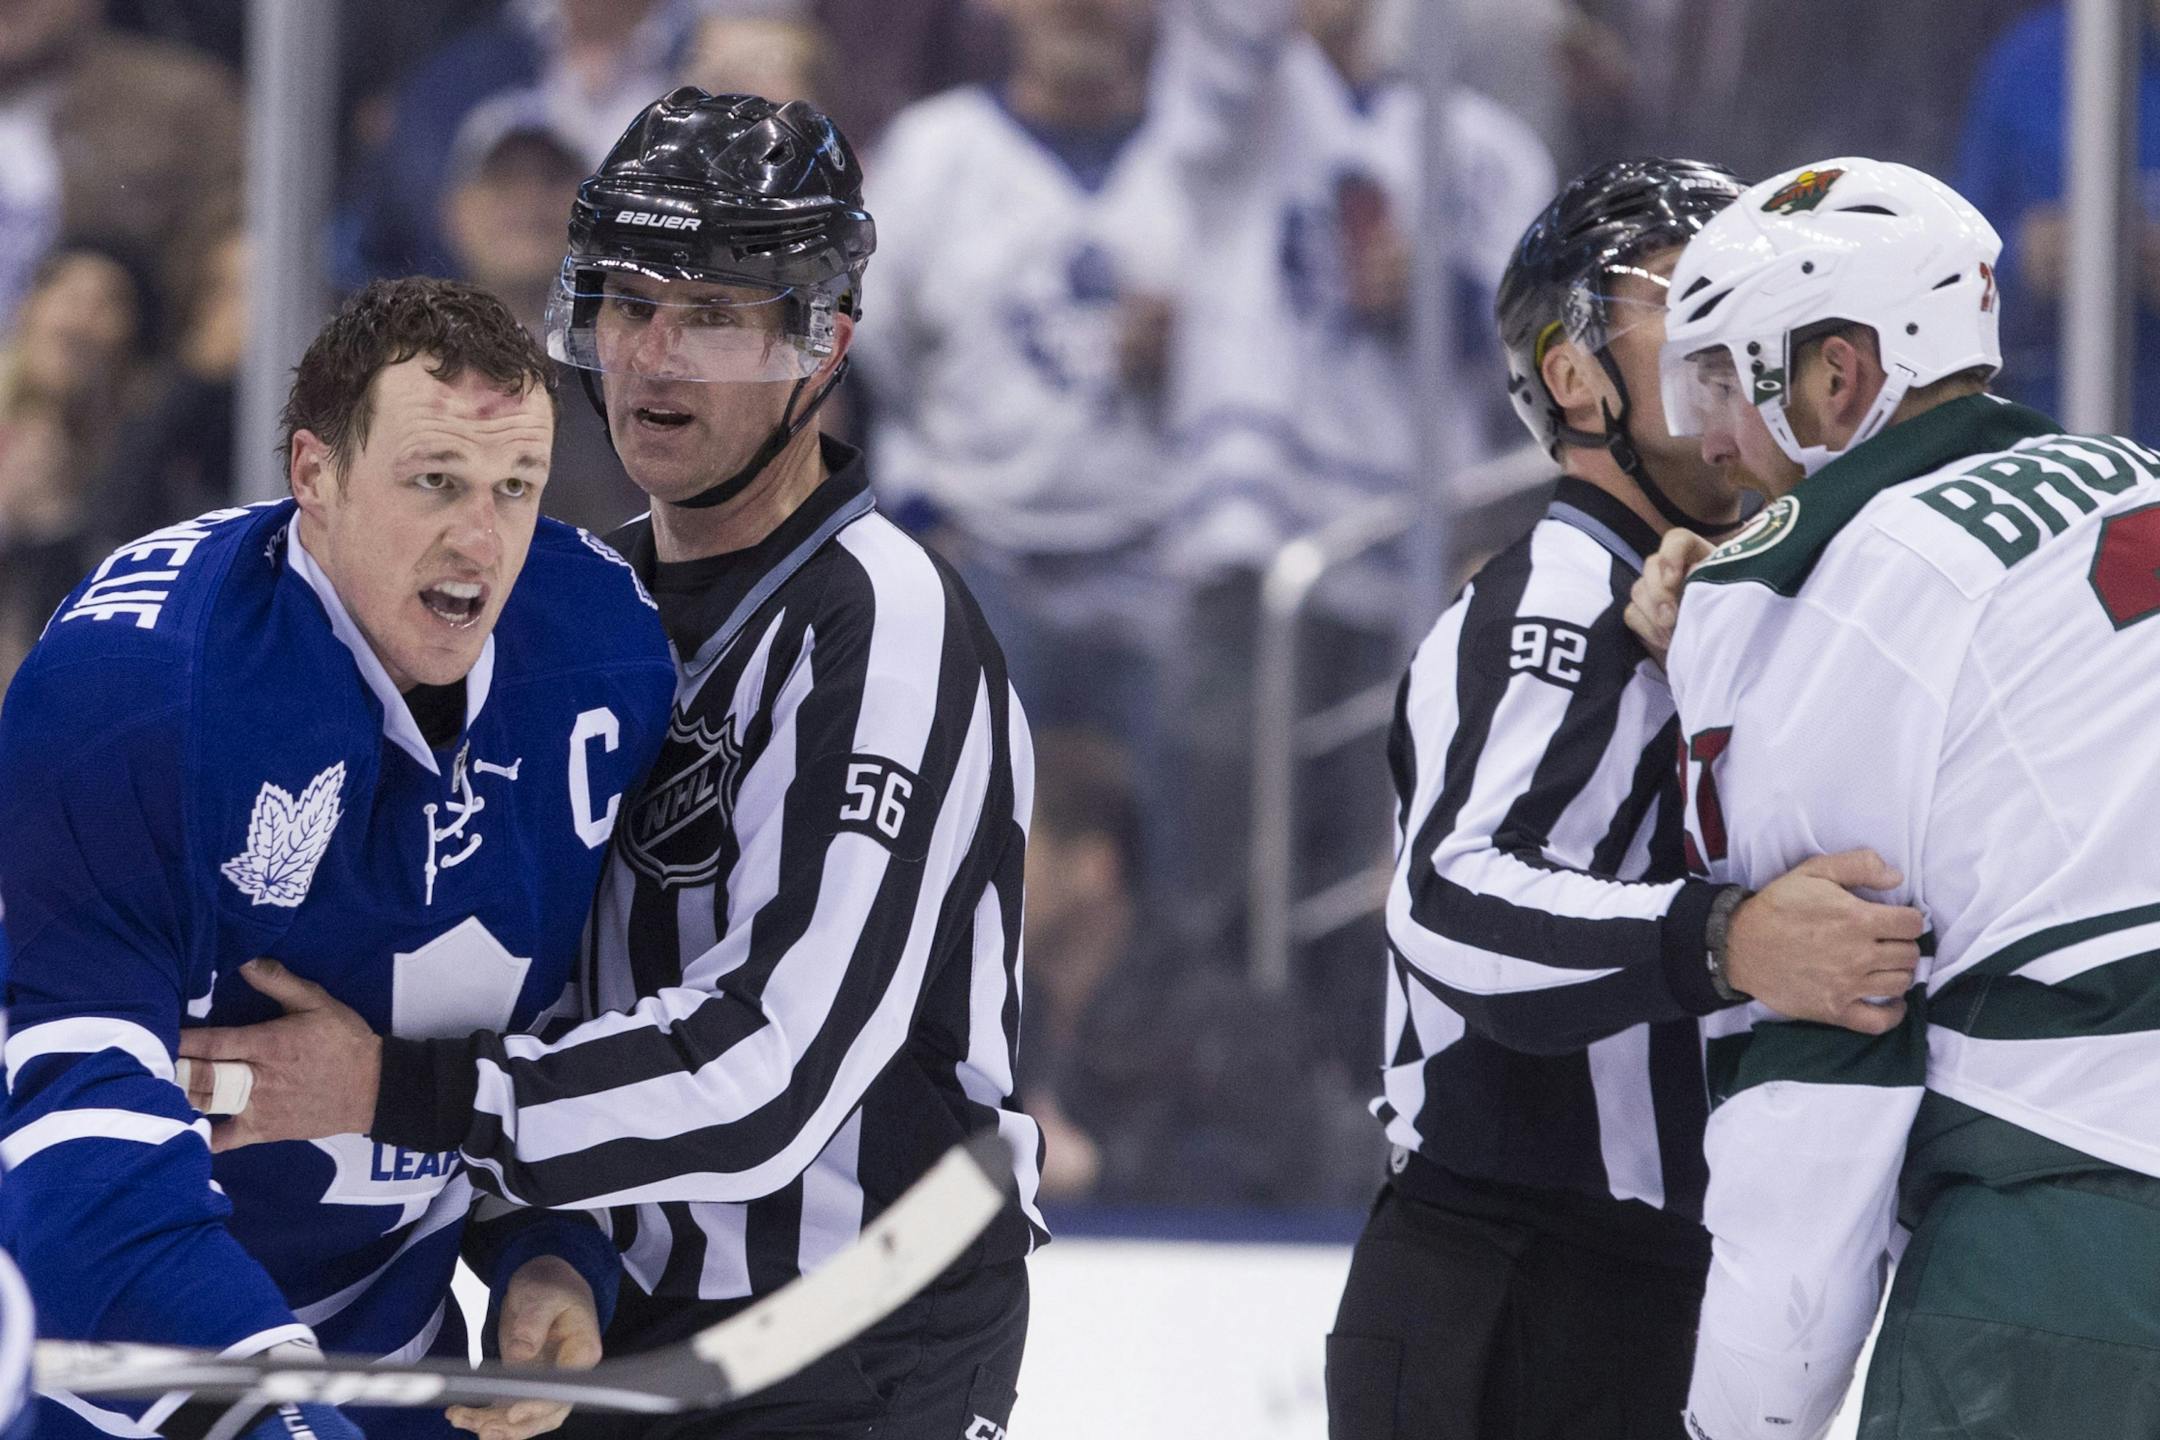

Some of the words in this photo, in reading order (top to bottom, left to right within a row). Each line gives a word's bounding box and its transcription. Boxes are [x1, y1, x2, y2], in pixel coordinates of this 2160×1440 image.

[615, 210, 702, 231] BAUER
[1510, 623, 1587, 683] 92
[568, 706, 622, 849] C
[641, 766, 715, 840] NHL
[839, 763, 913, 839] 56
